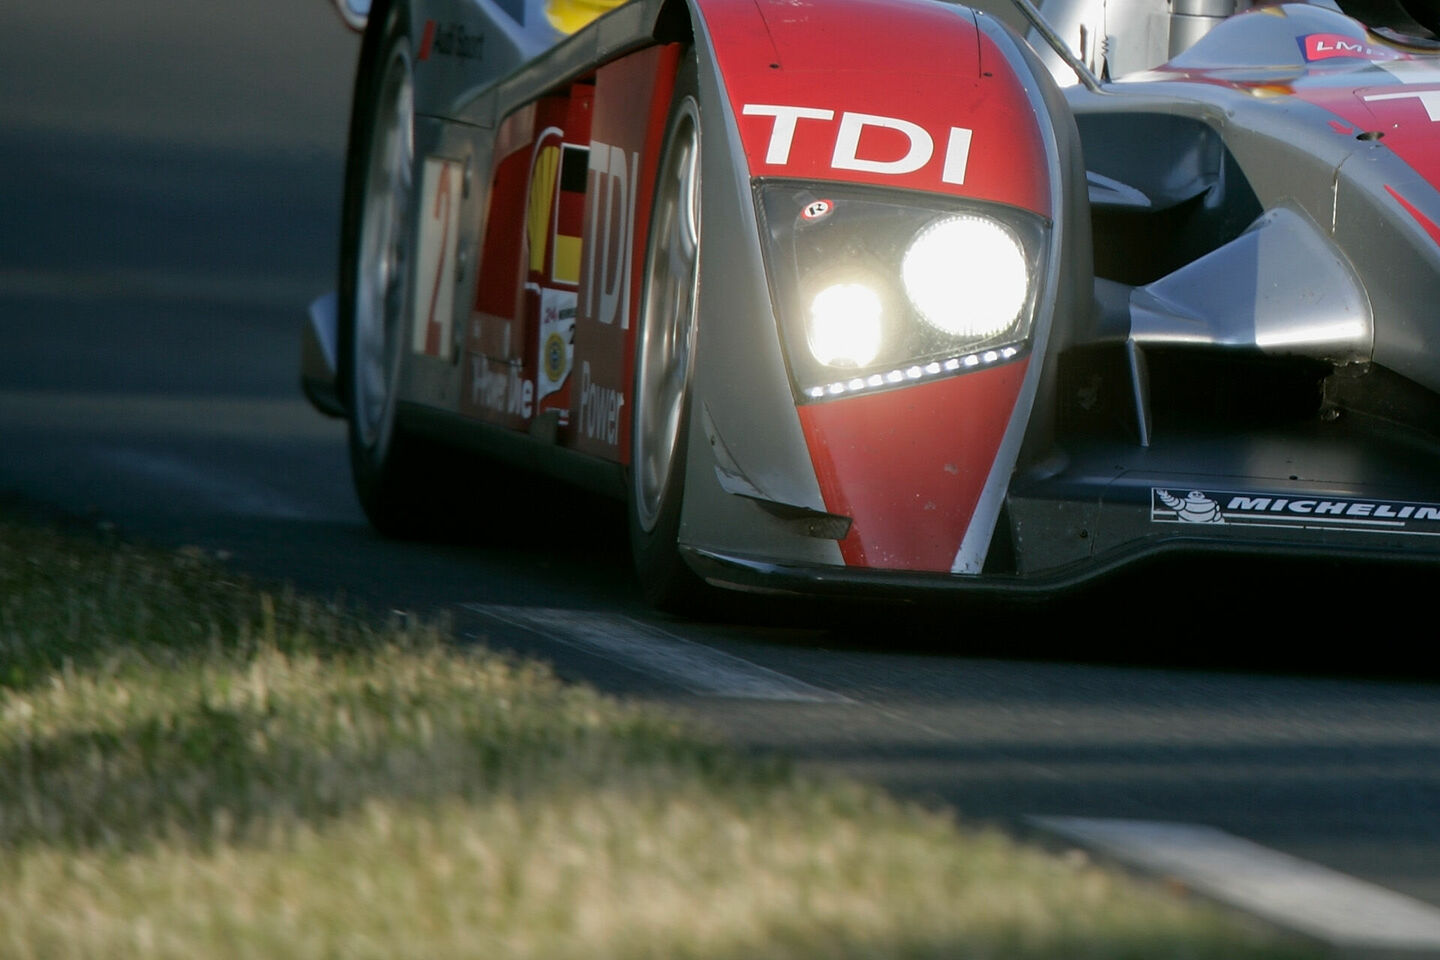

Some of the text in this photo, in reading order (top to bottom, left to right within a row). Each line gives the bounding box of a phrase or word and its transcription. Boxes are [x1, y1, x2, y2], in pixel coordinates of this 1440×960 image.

[741, 103, 973, 185] TDI
[586, 140, 640, 330] TDI
[578, 361, 625, 446] Power
